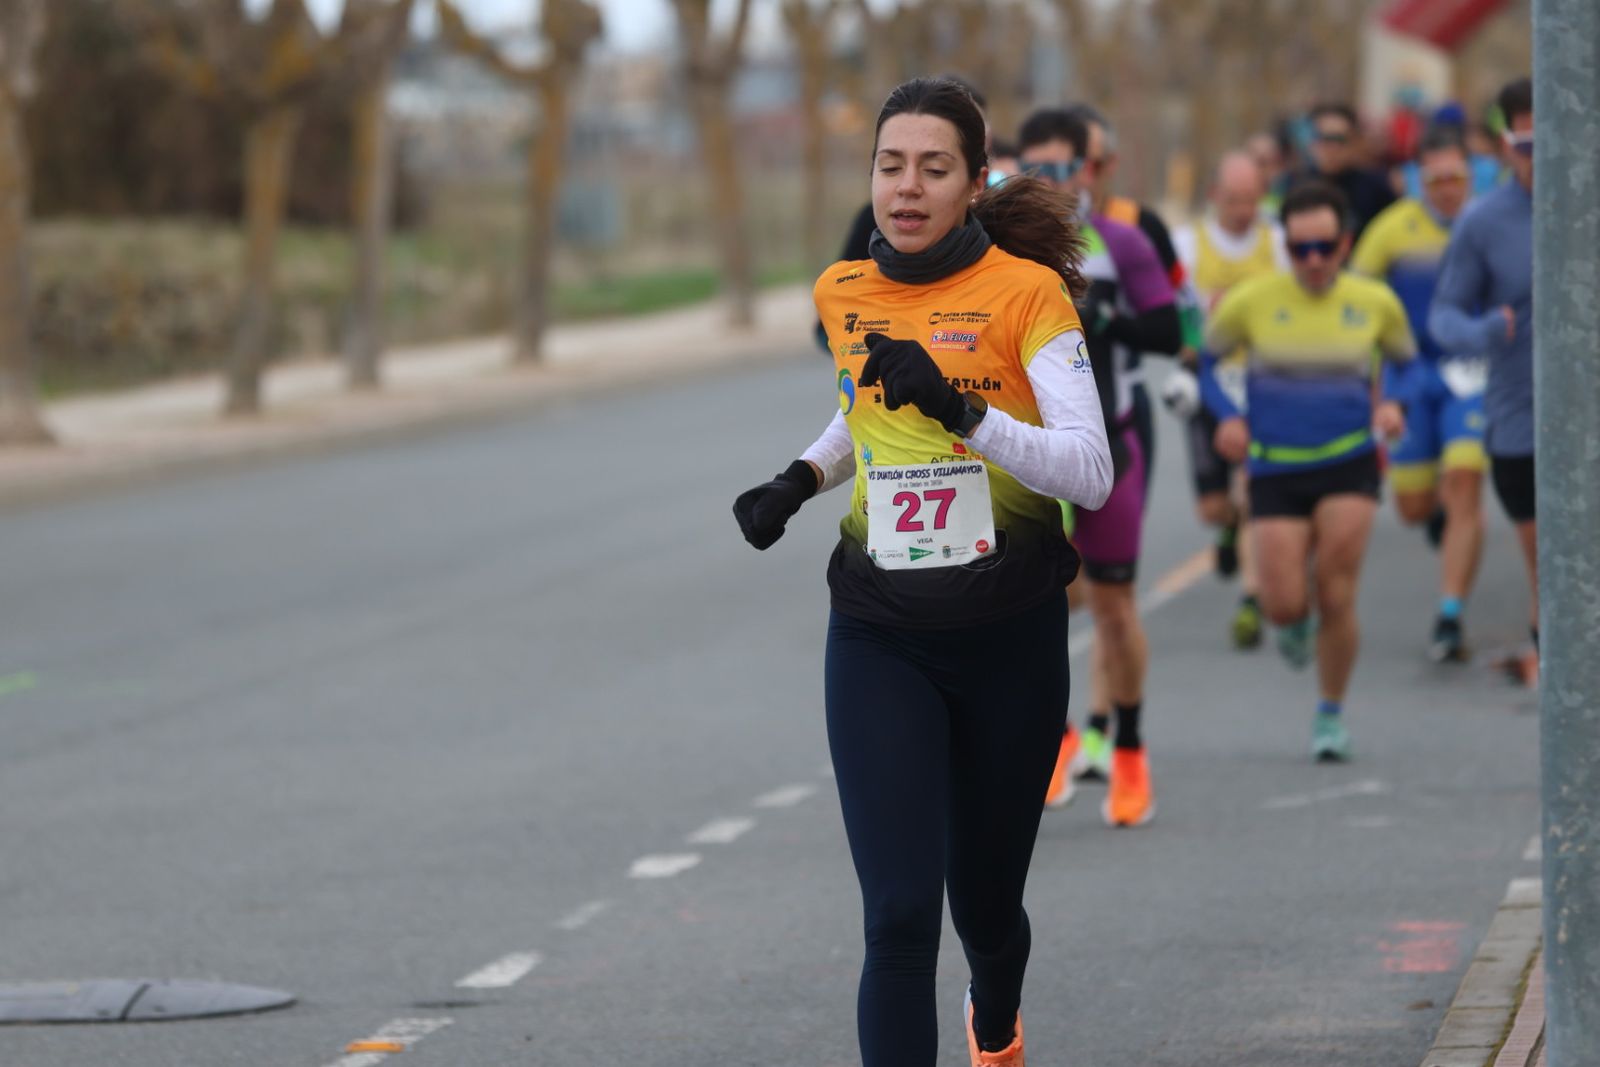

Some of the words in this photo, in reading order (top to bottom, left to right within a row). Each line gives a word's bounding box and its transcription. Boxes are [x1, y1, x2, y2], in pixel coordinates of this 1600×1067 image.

[877, 470, 903, 481] DUATLÓN
[905, 468, 931, 480] CROSS
[933, 465, 983, 478] VILLAMAYOR
[892, 488, 957, 532] 27
[917, 537, 933, 545] VEGA
